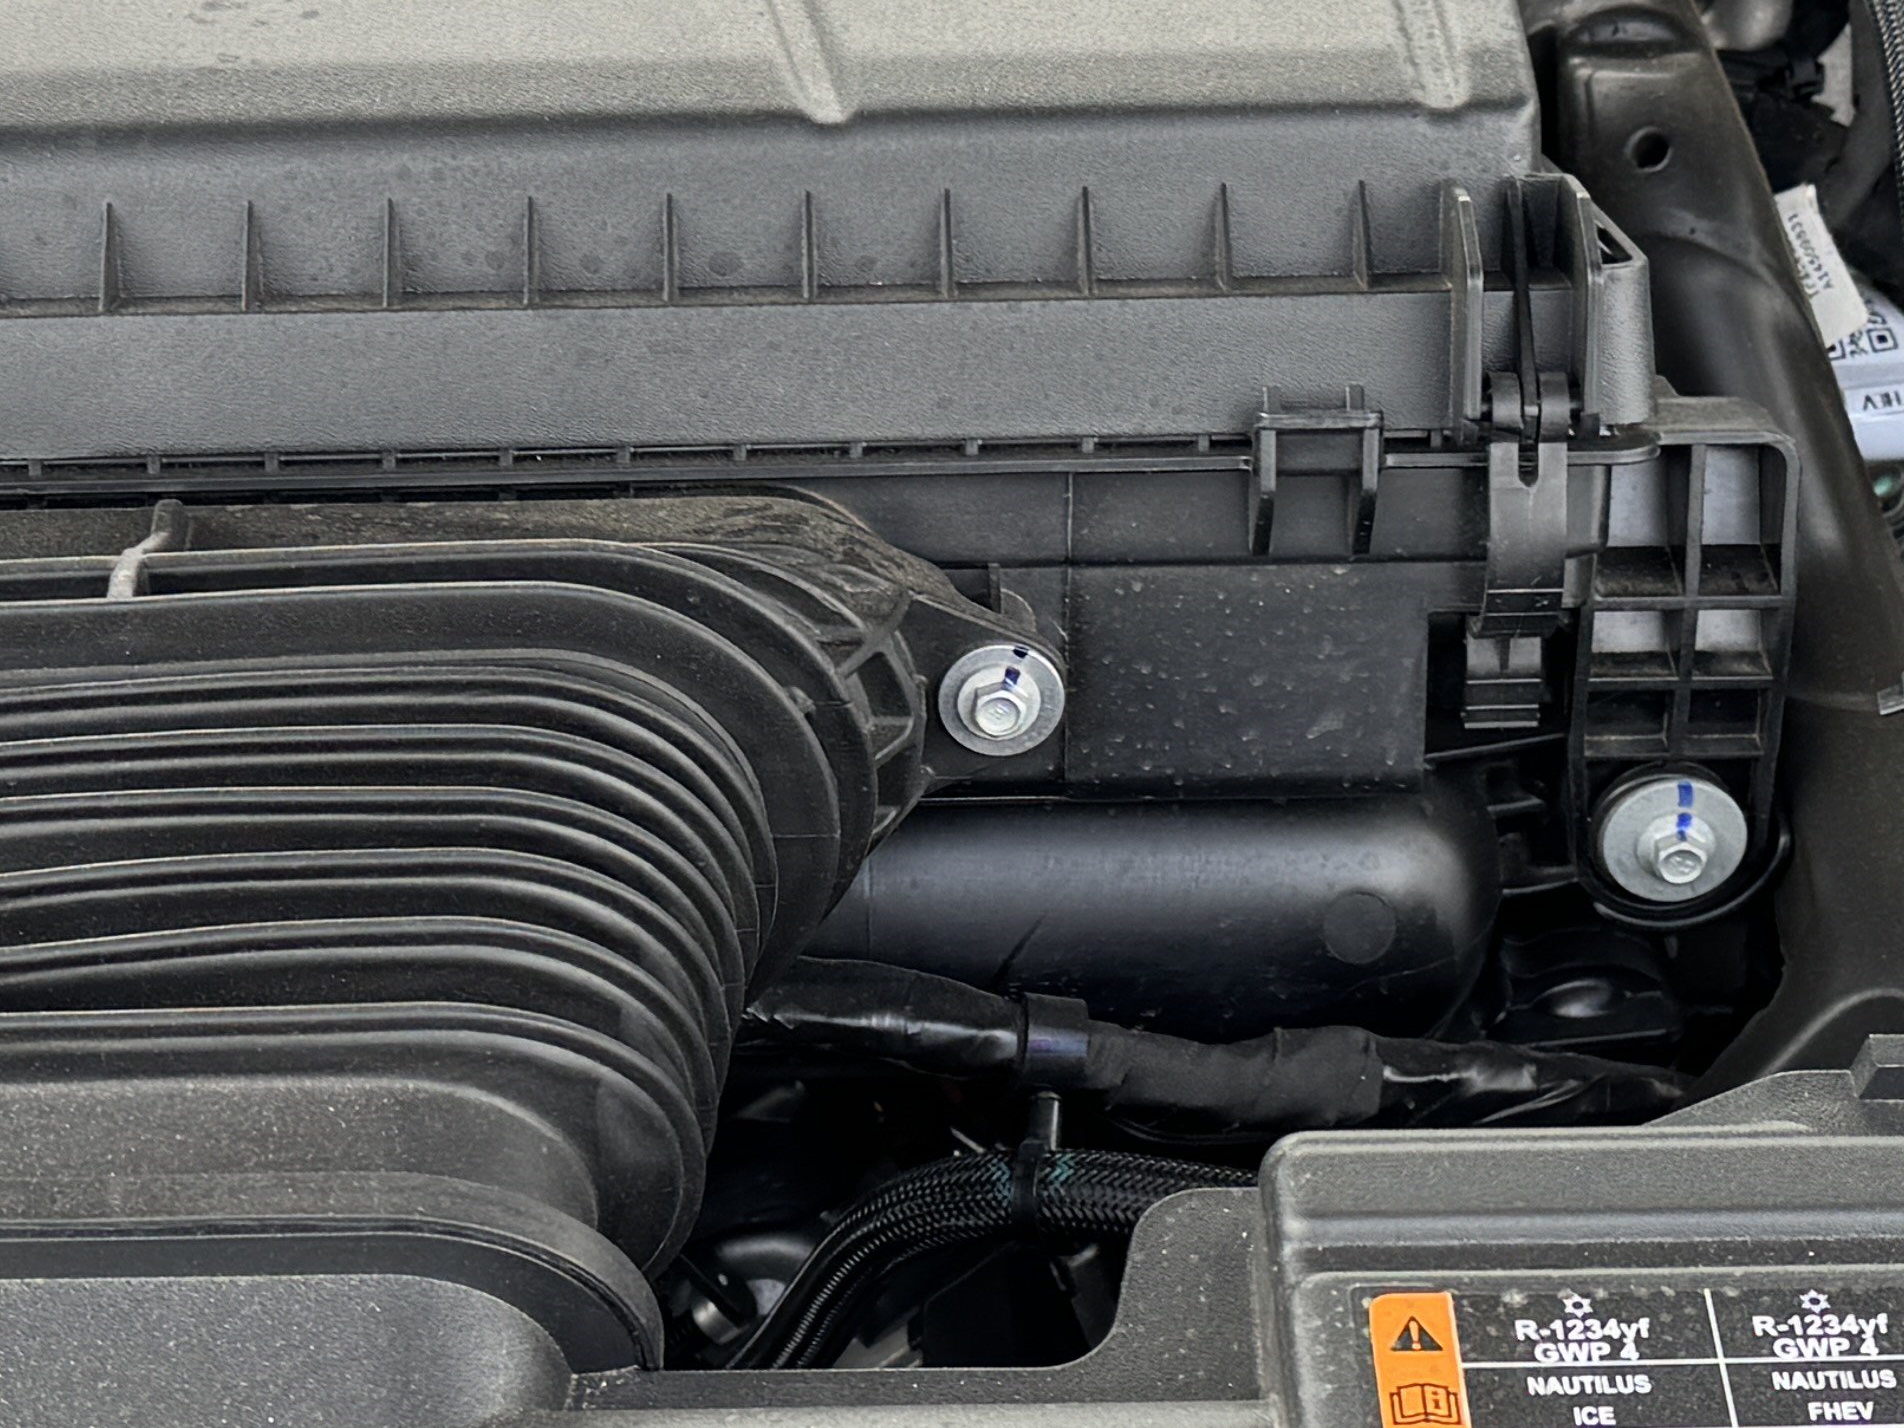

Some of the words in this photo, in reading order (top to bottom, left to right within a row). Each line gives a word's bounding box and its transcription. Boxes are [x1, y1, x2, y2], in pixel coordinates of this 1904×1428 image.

[1515, 1317, 1651, 1343] R-1234yf
[1752, 1312, 1889, 1339] R-1234yf
[1534, 1342, 1611, 1363] GWP
[1620, 1341, 1640, 1361] 4
[1773, 1337, 1851, 1359] GWP
[1859, 1337, 1879, 1357] 4
[1526, 1374, 1653, 1396] NAUTILUS
[1771, 1369, 1898, 1391] NAUTILUS
[1573, 1406, 1617, 1427] ICE
[1807, 1401, 1875, 1422] FHEV
